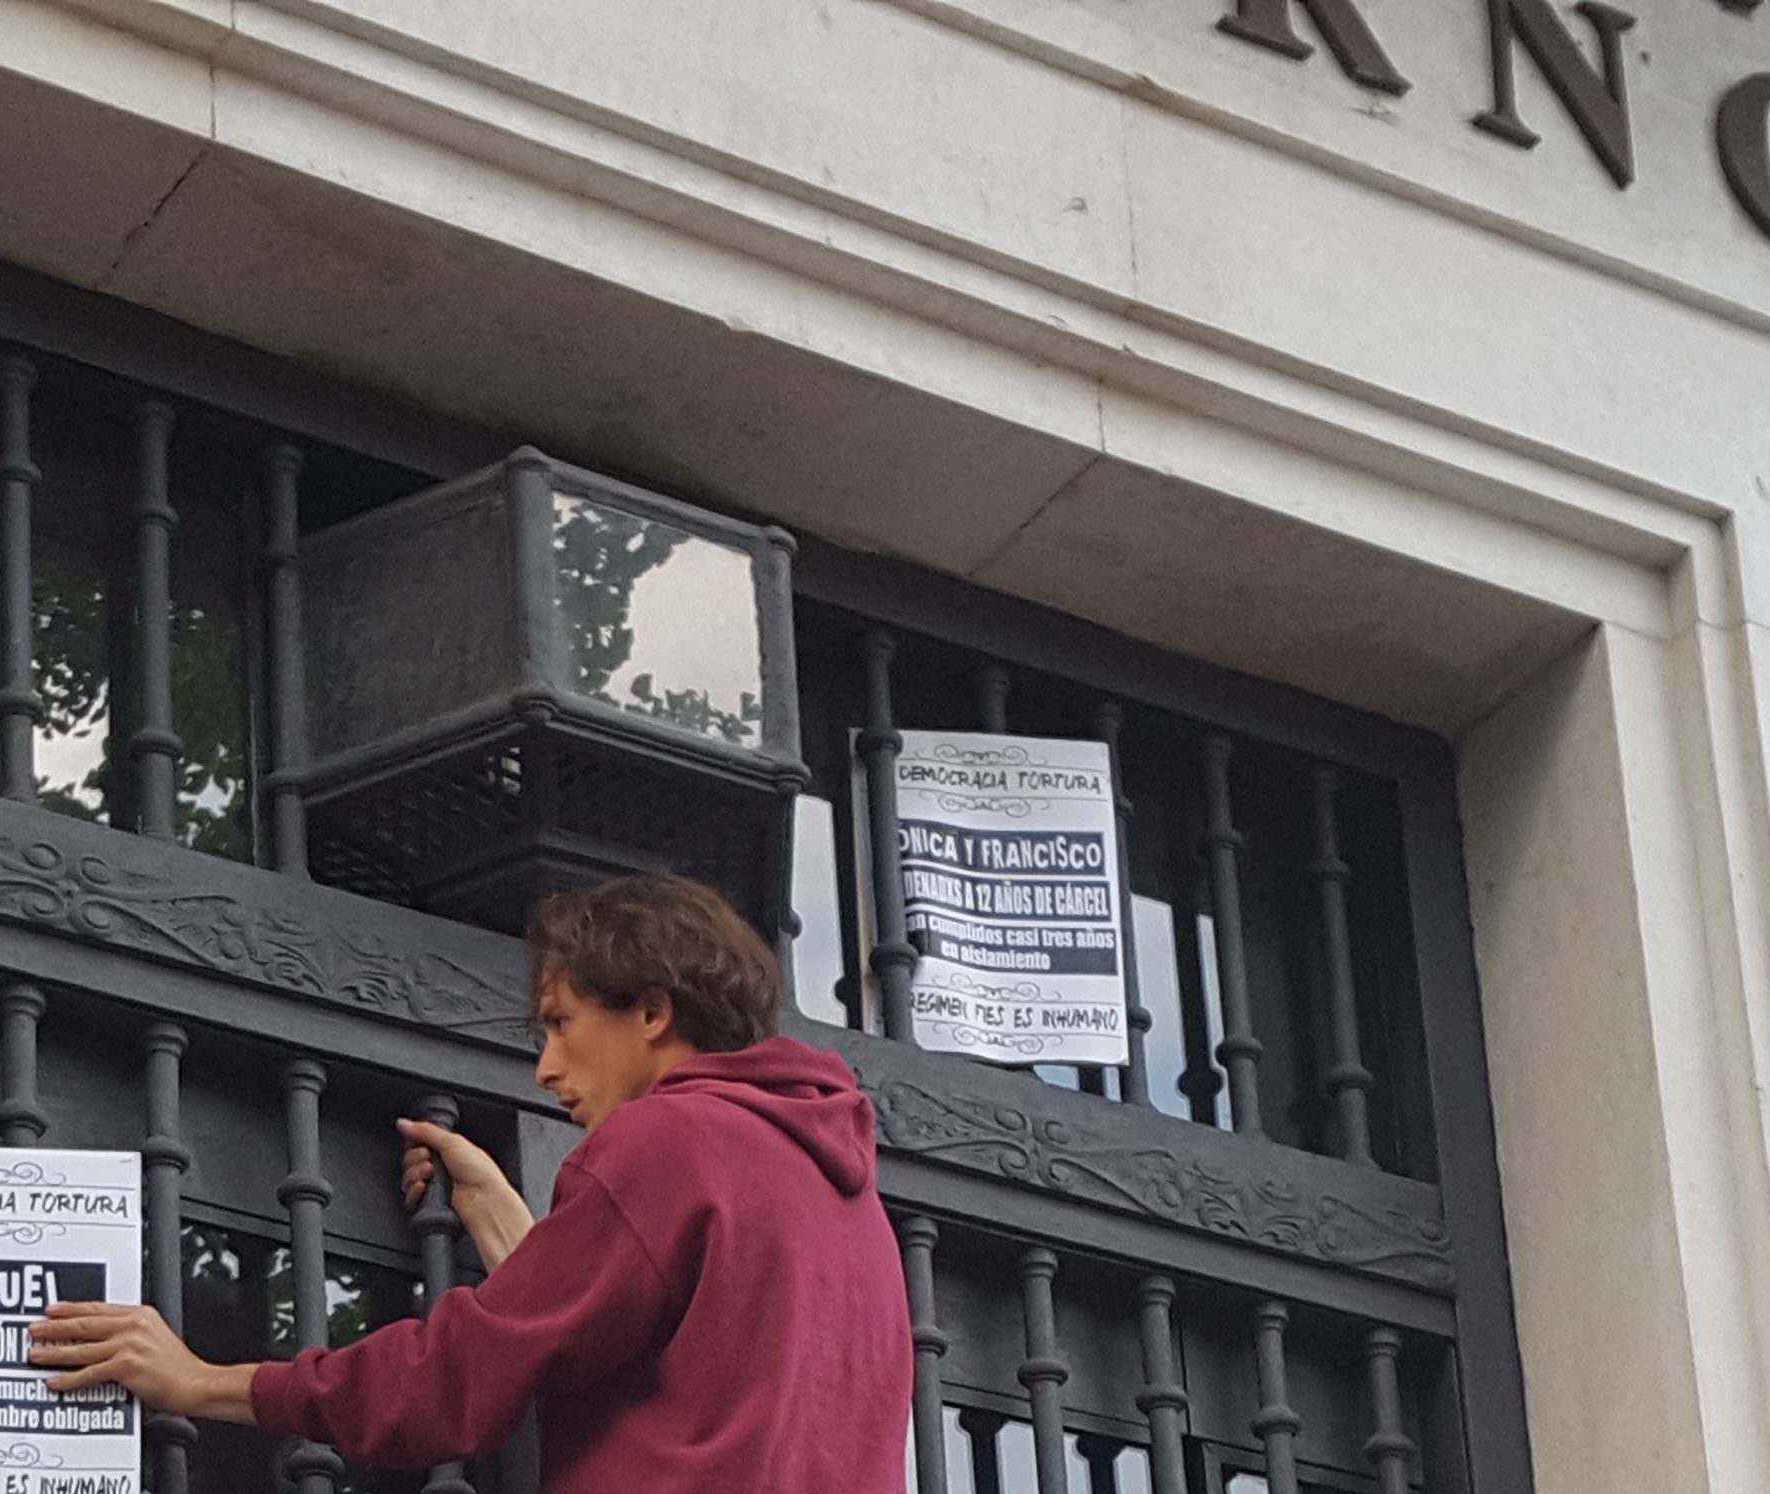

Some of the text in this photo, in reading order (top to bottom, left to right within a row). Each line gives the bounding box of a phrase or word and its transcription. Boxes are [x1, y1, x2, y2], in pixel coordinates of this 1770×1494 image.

[1017, 772, 1102, 795] TORTURA
[964, 838, 974, 866] Y
[982, 836, 1102, 870] FRANCISCO
[976, 884, 992, 913] 12
[994, 881, 1032, 915] AÑOS
[1034, 886, 1053, 915] DE
[1055, 883, 1110, 917] CÁRCEL
[929, 914, 1004, 946] cumplidos
[1006, 928, 1040, 947] casi
[1042, 929, 1074, 948] tres
[1076, 929, 1115, 949] años
[940, 940, 1051, 971] en aislamiento
[1014, 1008, 1033, 1028] ES
[1041, 1008, 1119, 1032] INHUMANO
[29, 1191, 130, 1220] TORTURA
[42, 1406, 125, 1433] obligada
